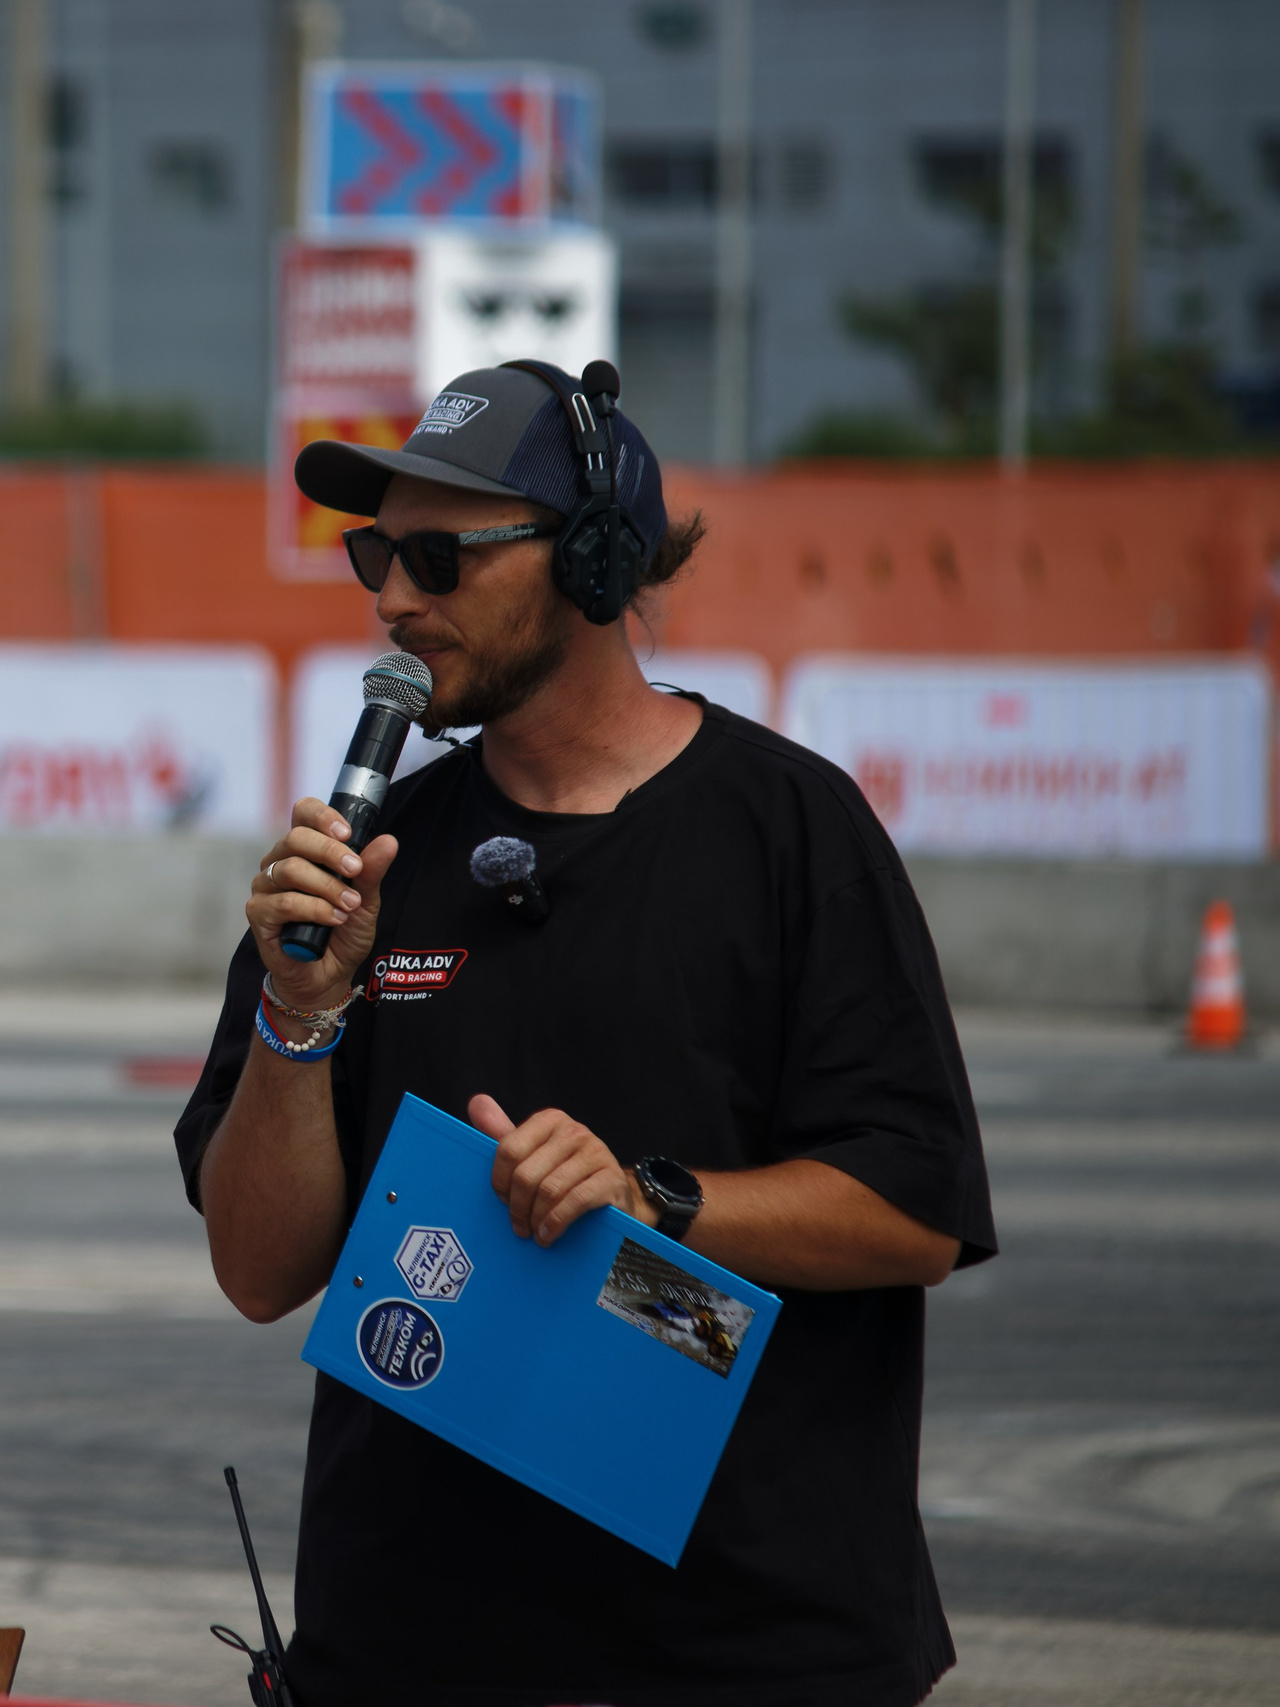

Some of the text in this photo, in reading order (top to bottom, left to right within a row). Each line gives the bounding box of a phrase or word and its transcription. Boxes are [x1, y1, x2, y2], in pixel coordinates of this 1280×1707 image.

[446, 398, 476, 412] ADV
[423, 955, 454, 969] ADV
[384, 972, 443, 982] PRO RACING
[404, 992, 427, 1001] BRAND
[407, 1233, 432, 1276] ЧЕЛЯБИНСК
[412, 1233, 447, 1290] G-TAXI
[369, 1311, 387, 1356] ЧЕЛЯБИНСК
[389, 1311, 417, 1376] ТЕХКОМ
